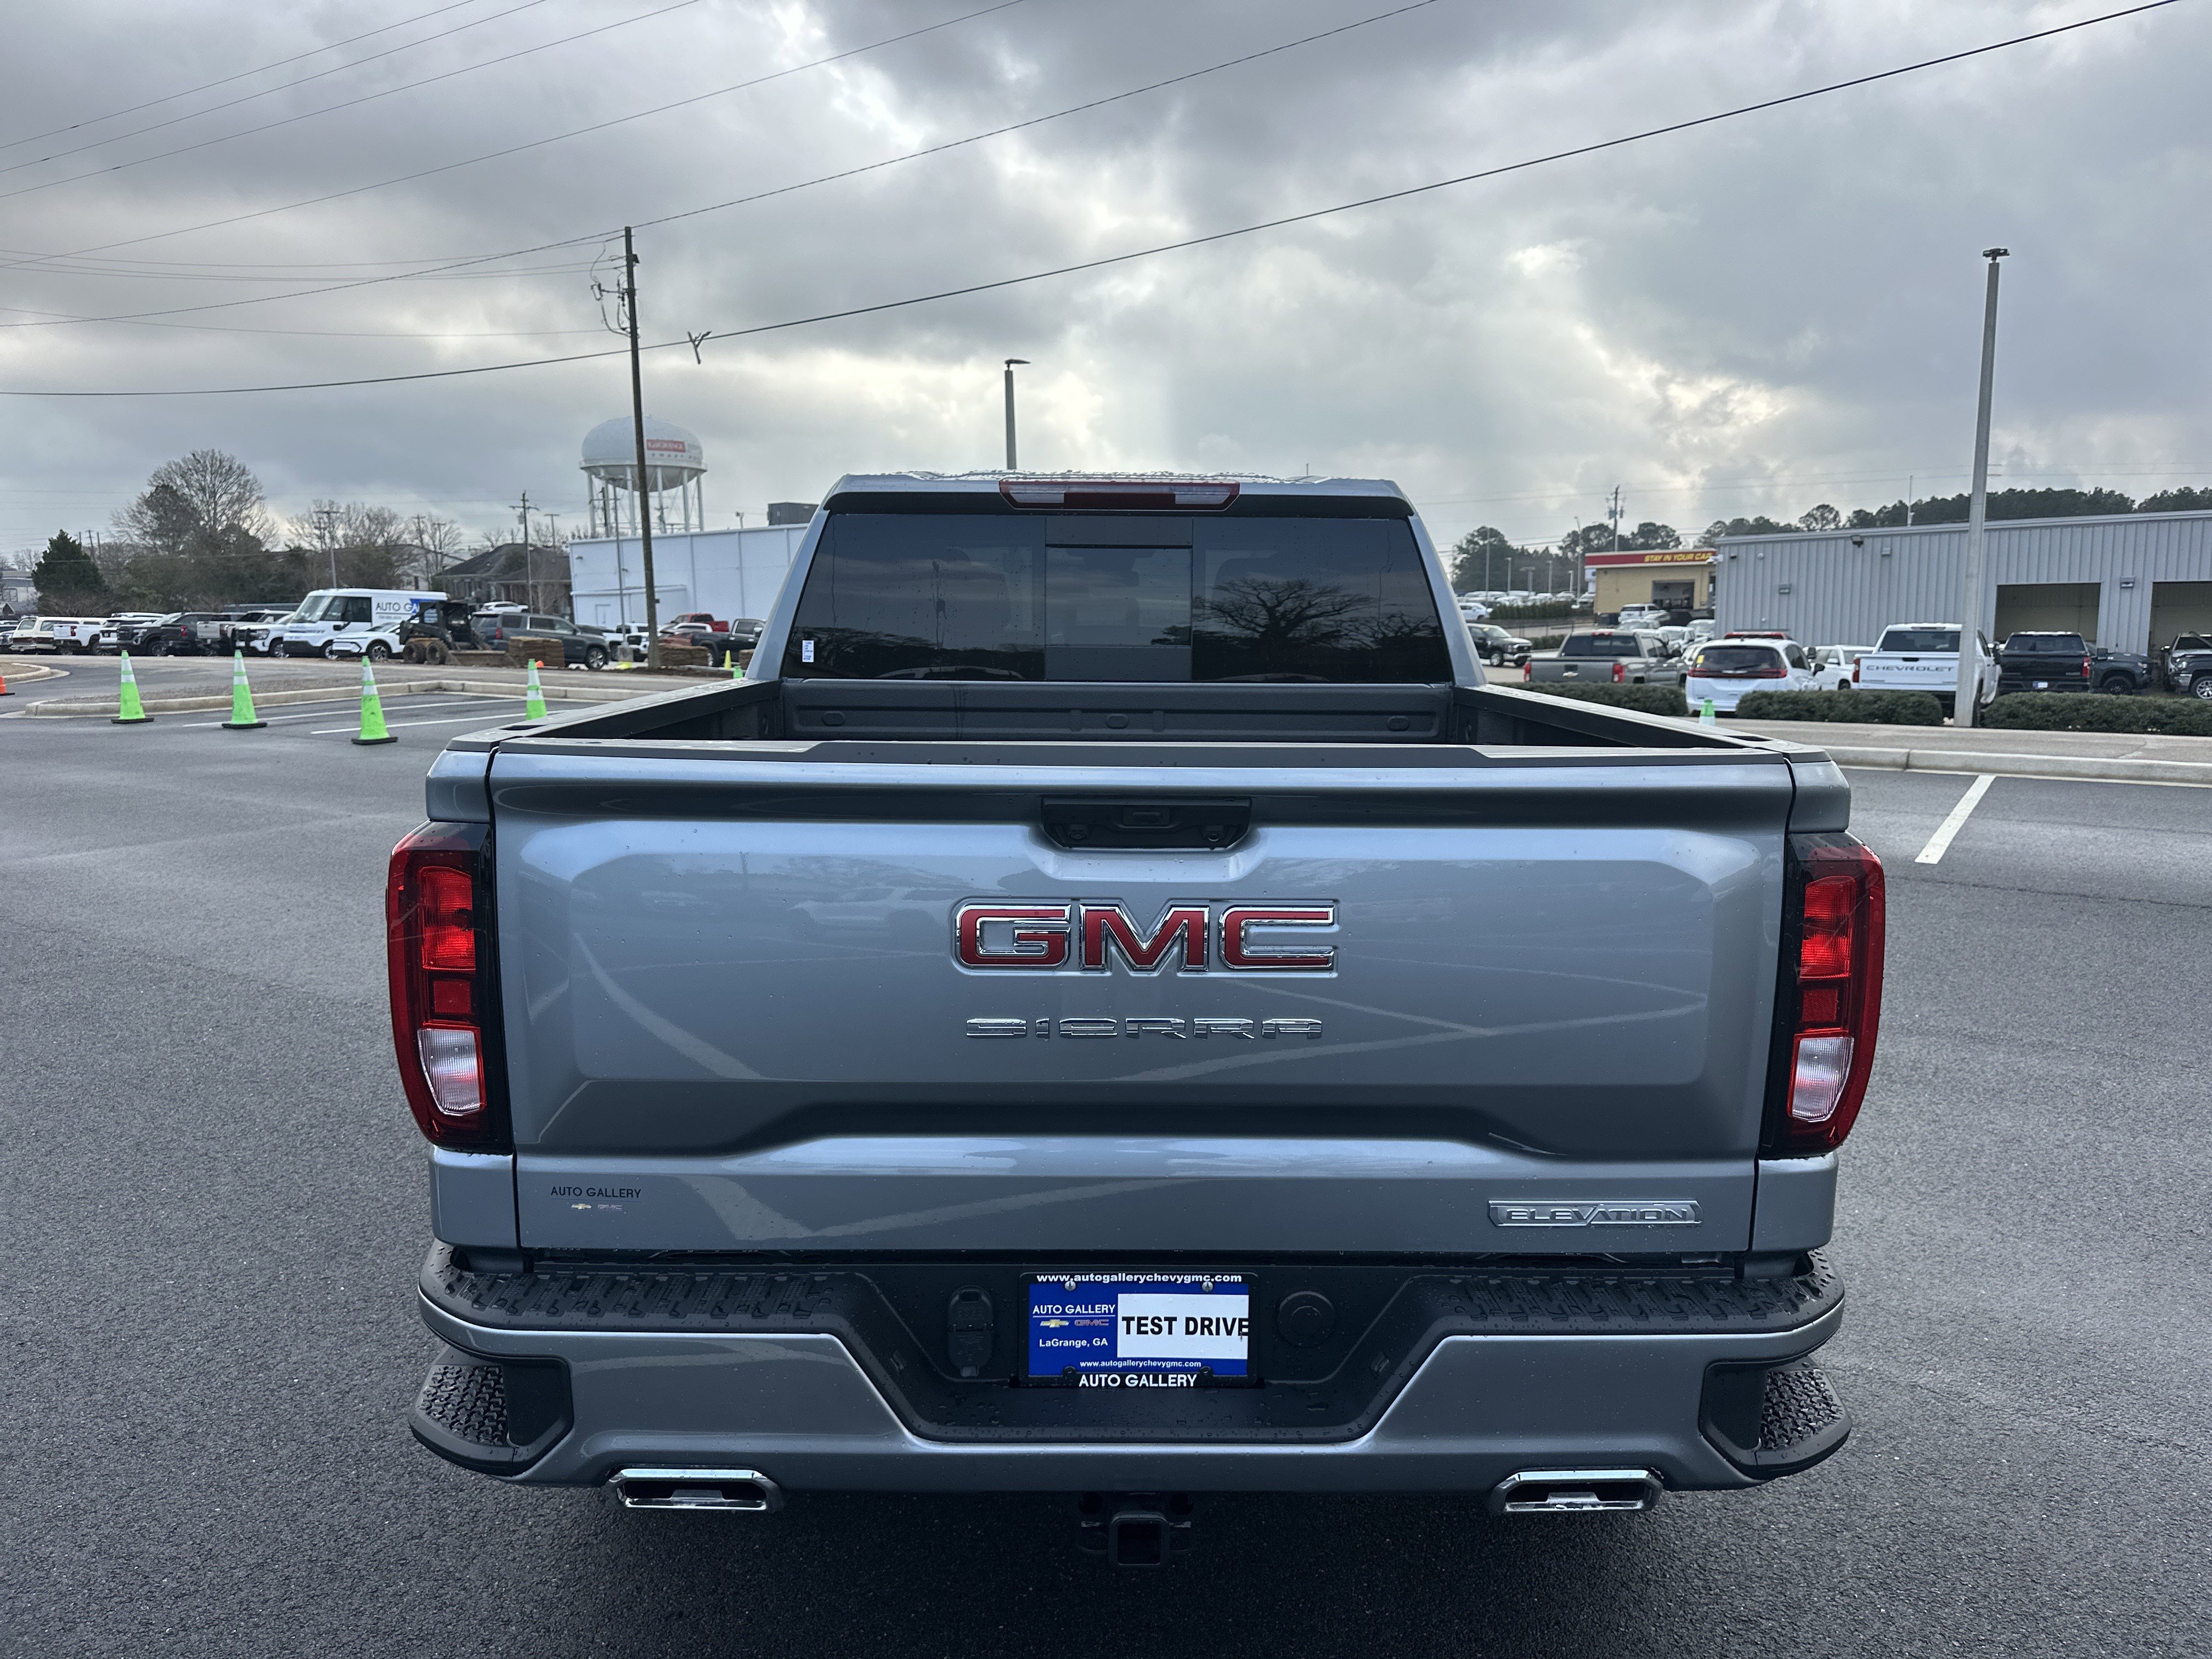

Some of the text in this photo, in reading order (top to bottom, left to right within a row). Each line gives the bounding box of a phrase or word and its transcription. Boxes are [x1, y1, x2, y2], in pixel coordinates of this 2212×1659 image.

[1644, 554, 1663, 562] STAY
[376, 602, 400, 612] AUTO
[956, 903, 1335, 972] GMC
[966, 1018, 1323, 1039] SIERRA
[551, 1186, 641, 1198] AUTO GALLERY
[1506, 1209, 1688, 1221] ELEVATION
[1036, 1273, 1242, 1283] www.autogallerychevygmc.com
[1032, 1304, 1115, 1314] AUTO GALLERY
[1122, 1316, 1249, 1336] TEST DRIVE
[1039, 1338, 1108, 1347] LaGrange, GA
[1080, 1359, 1201, 1368] www.autogallerychevygmc.com
[1079, 1374, 1198, 1387] AUTO GALLERY
